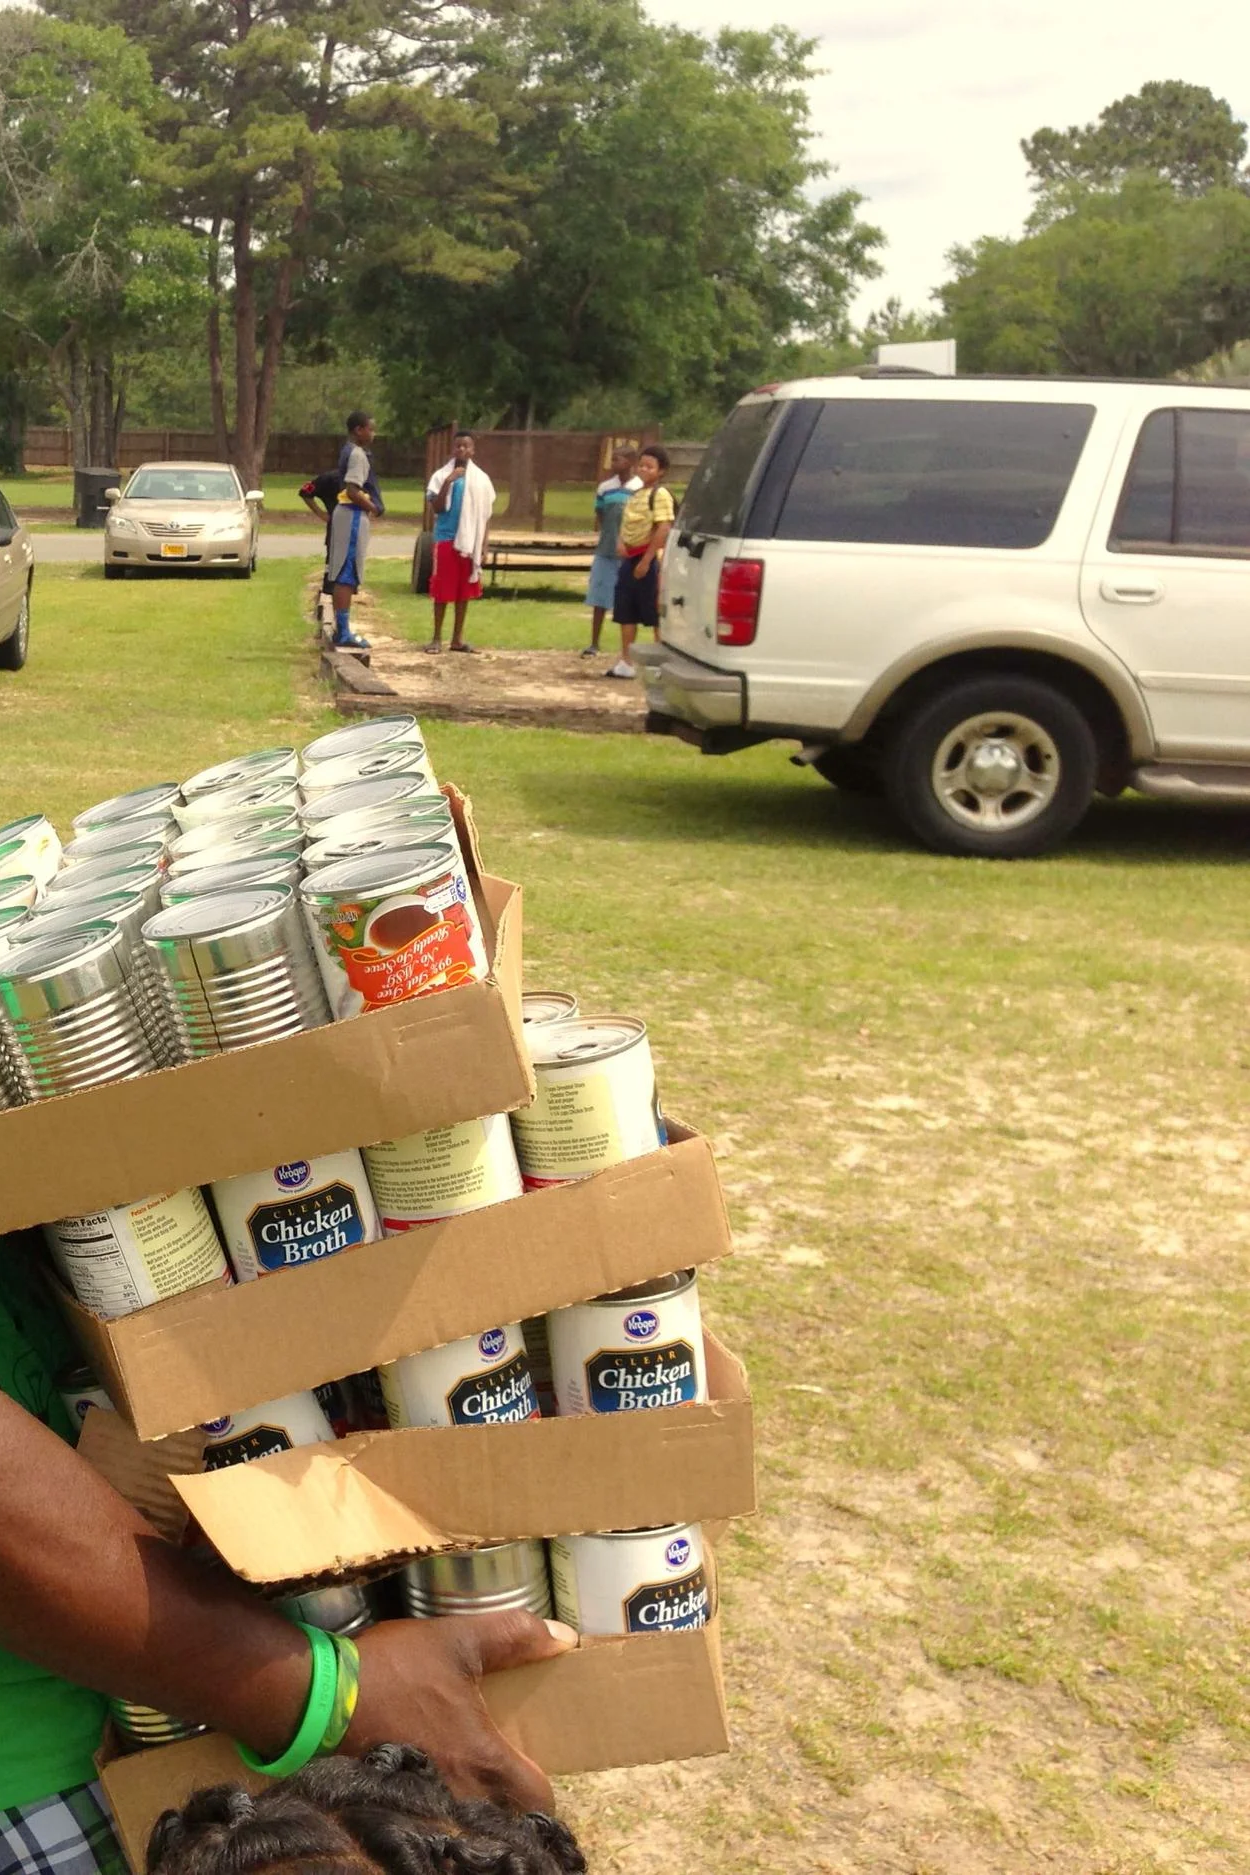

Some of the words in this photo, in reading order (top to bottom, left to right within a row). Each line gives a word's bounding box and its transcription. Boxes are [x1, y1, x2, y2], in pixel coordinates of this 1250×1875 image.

[413, 926, 449, 954] Ready
[364, 958, 397, 975] Serve
[396, 950, 413, 967] To
[421, 947, 438, 967] No
[407, 970, 428, 990] Fat
[377, 984, 403, 1000] Free
[278, 1161, 308, 1183] Kroger
[273, 1195, 334, 1218] CLEAR
[80, 1215, 108, 1227] Facts
[261, 1203, 353, 1244] Chicken
[283, 1229, 349, 1264] Broth
[628, 1315, 657, 1335] Kroger
[615, 1350, 677, 1366] CLEAR
[598, 1361, 691, 1389] Chicken
[462, 1370, 532, 1417] Chicken
[617, 1382, 683, 1410] Broth
